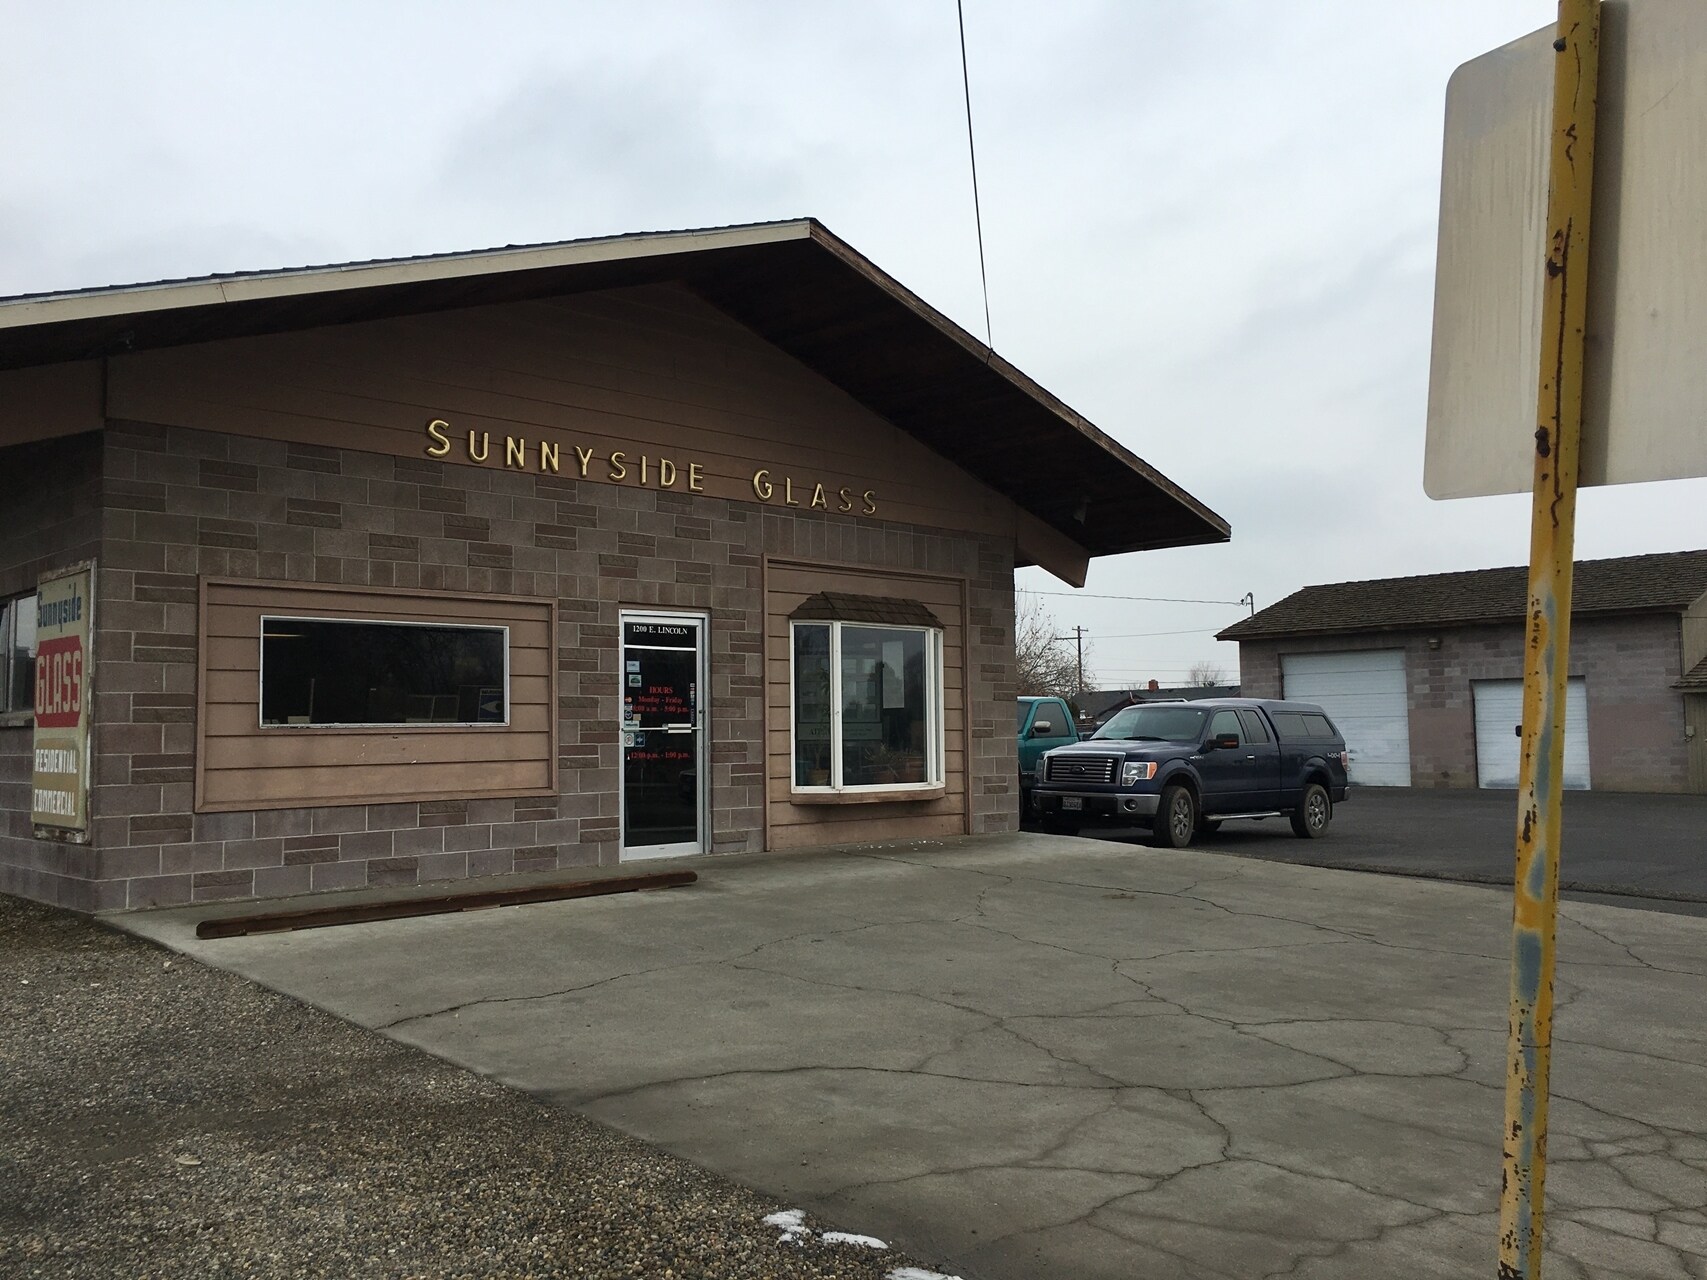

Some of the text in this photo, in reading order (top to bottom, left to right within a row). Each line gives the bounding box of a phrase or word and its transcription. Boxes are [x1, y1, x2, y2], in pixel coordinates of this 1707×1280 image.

[425, 419, 877, 516] SUNNYSIDE GLASS
[37, 582, 82, 633] Sunnyside
[633, 625, 647, 633] 1200
[657, 626, 688, 635] LINCOLN
[35, 650, 82, 716] GLASS
[649, 686, 673, 695] HOURS
[665, 696, 683, 705] Friday
[34, 748, 78, 774] RESIDENTIAL
[33, 788, 76, 816] COMMERCIAL
